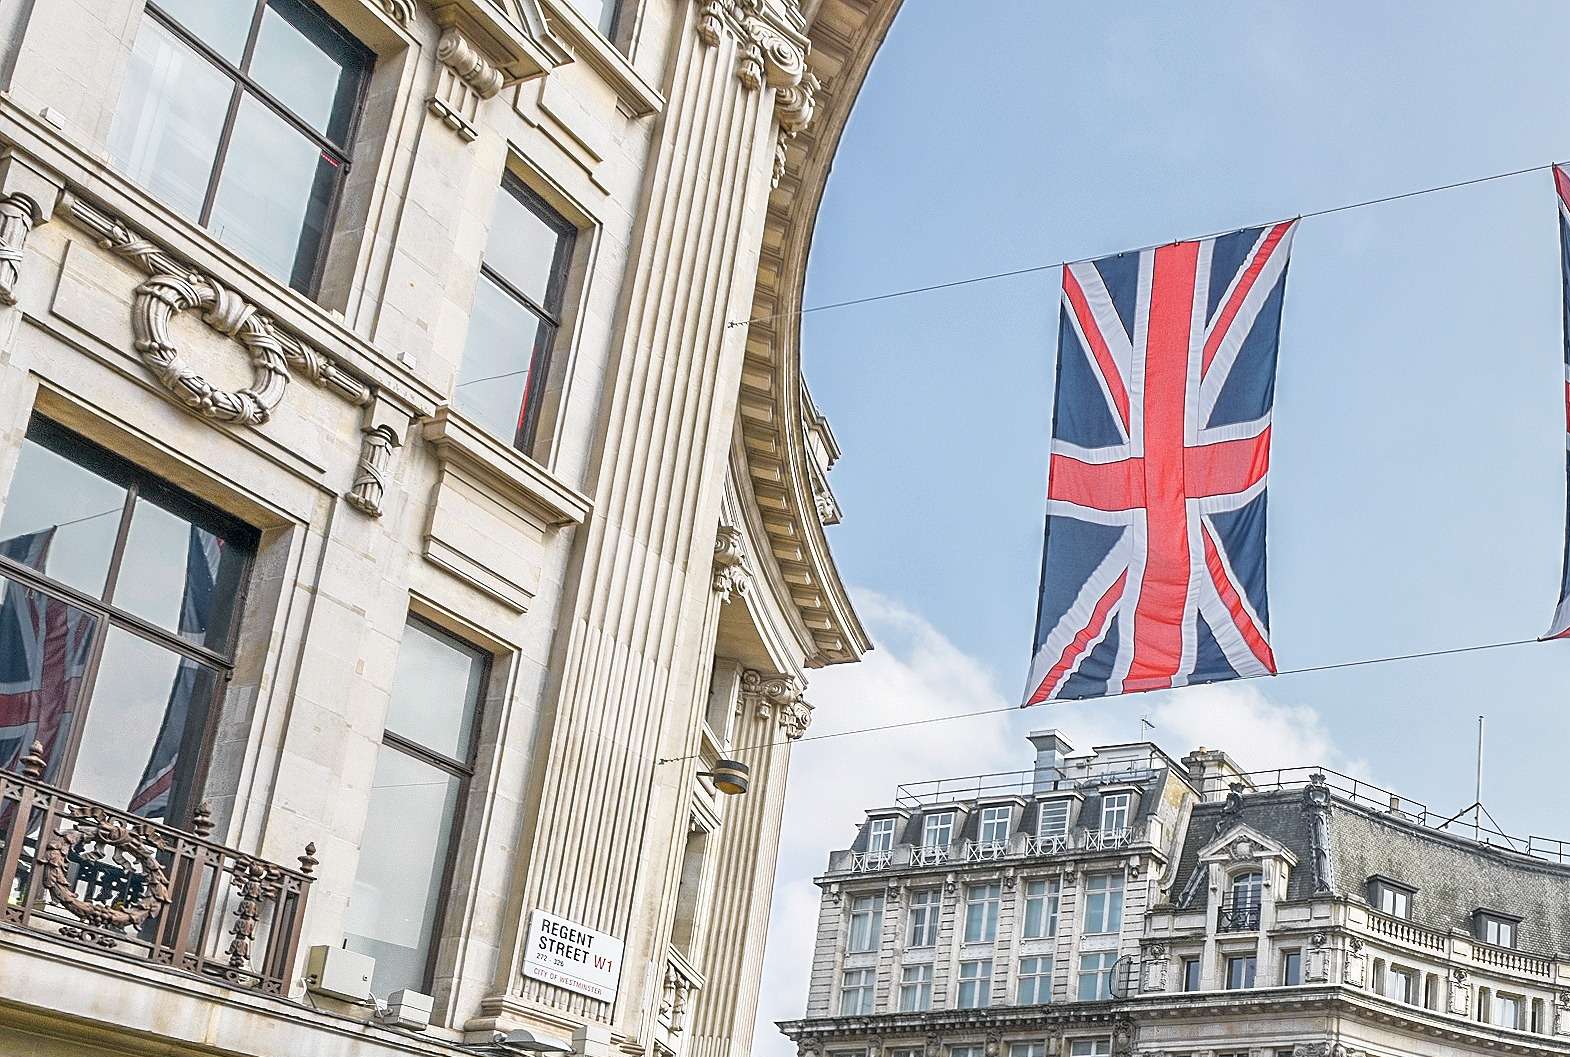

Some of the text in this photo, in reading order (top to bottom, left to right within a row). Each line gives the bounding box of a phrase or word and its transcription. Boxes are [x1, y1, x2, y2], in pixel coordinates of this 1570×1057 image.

[541, 918, 595, 948] REGENT
[536, 952, 548, 962] 272
[538, 936, 614, 973] STREET W1
[533, 967, 602, 995] CITY OF WESTMINSTER
